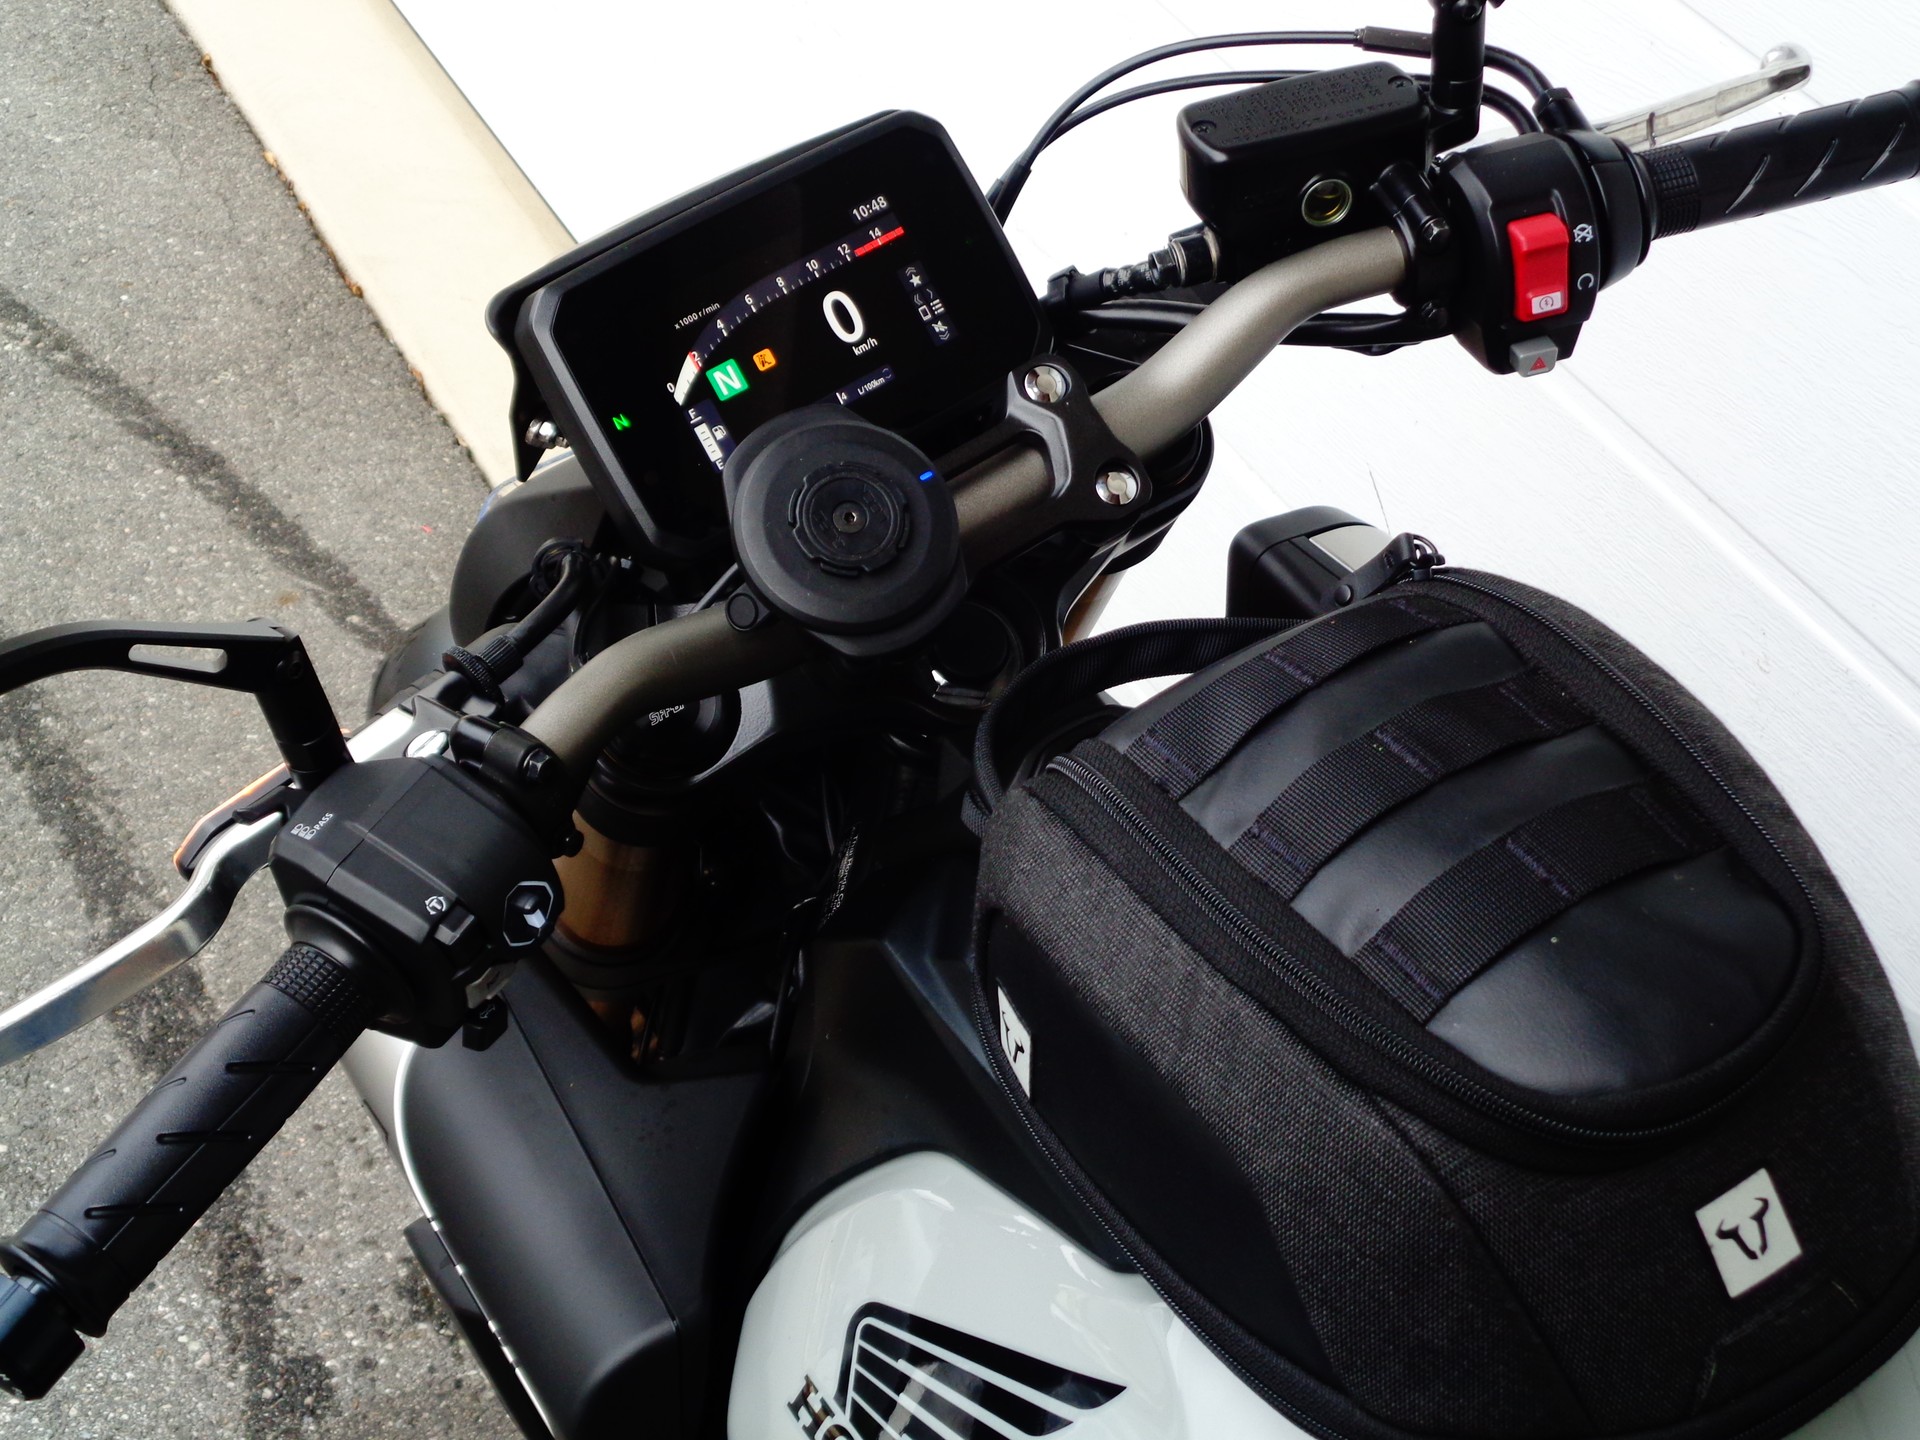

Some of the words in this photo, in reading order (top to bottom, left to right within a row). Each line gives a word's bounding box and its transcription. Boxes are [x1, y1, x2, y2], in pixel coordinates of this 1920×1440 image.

[852, 196, 887, 220] 10:48
[869, 227, 882, 240] 14
[837, 243, 851, 256] 12
[805, 259, 819, 272] 10
[775, 276, 785, 288] 8
[744, 294, 753, 305] 6
[674, 312, 699, 330] x1000
[698, 302, 720, 317] r/min
[822, 290, 864, 343] 0
[716, 318, 724, 329] 4
[852, 337, 878, 357] km/h
[691, 351, 700, 362] 2
[713, 365, 742, 396] N
[857, 377, 885, 395] L/100km
[666, 382, 675, 393] 0
[688, 408, 696, 419] F
[612, 413, 631, 430] N
[715, 459, 724, 470] E
[313, 812, 333, 830] PASS
